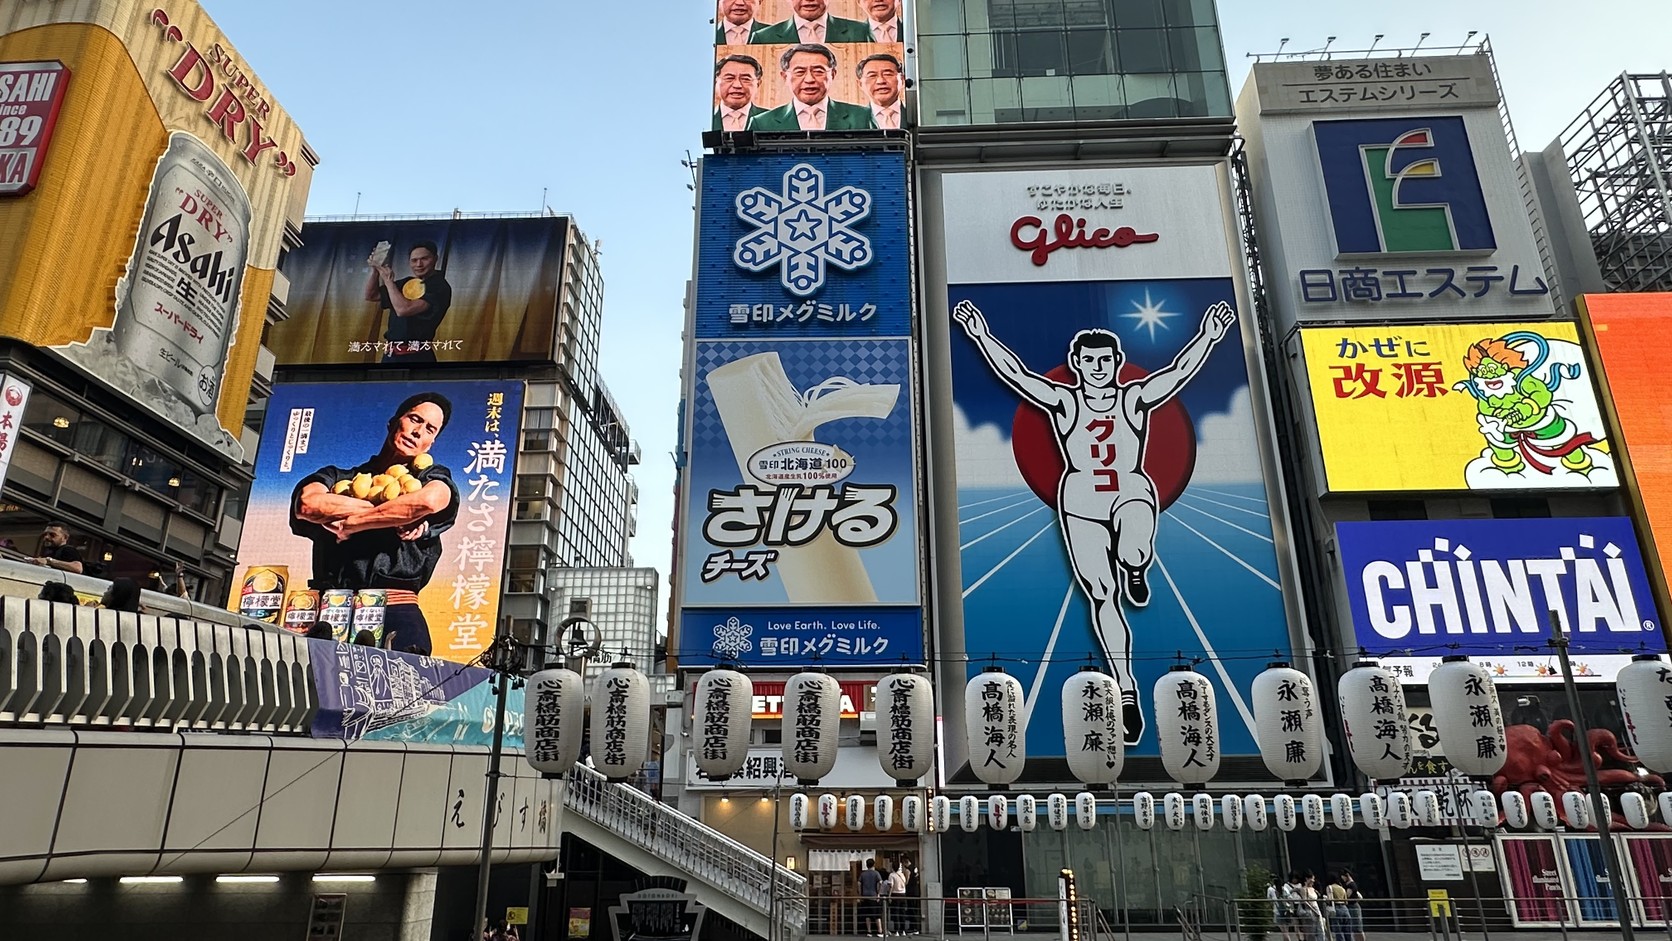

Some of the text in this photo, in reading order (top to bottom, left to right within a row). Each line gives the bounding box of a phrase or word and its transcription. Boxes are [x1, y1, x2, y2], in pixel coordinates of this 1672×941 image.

[208, 43, 270, 120] SUPER
[1299, 82, 1461, 104] エステムシリーズ
[1312, 62, 1432, 81] 夢ある住まい
[193, 188, 224, 220] SUPER
[150, 213, 235, 303] Asahi
[1010, 213, 1160, 267] Glico
[175, 276, 198, 307] 生
[1300, 264, 1549, 302] 日商エステム
[154, 301, 205, 345] スーパードライ
[729, 300, 877, 324] 雪印メグミルク
[1335, 335, 1432, 359] かぜに
[1329, 360, 1449, 400] 改源
[776, 446, 826, 458] STRING CHEESE
[1085, 415, 1120, 492] グリコ
[704, 485, 896, 546] さける
[448, 440, 508, 651] 満たさ檸檬堂
[703, 552, 777, 581] チーズ
[760, 634, 889, 656] 雪印メグミルク
[767, 620, 881, 631] Love Earth. Love Life.
[534, 678, 564, 763] 心斎橋筋商店街
[604, 677, 632, 766] 心斎橋筋商店街
[703, 677, 732, 761] 心斎橋筋商店街
[794, 679, 824, 764] 心斎橋筋商店街
[888, 678, 916, 770] 心斎橋筋商店街
[1081, 681, 1106, 752] 永瀬廉
[1277, 680, 1306, 763] 永瀬廉
[1464, 674, 1498, 759] 永瀬廉
